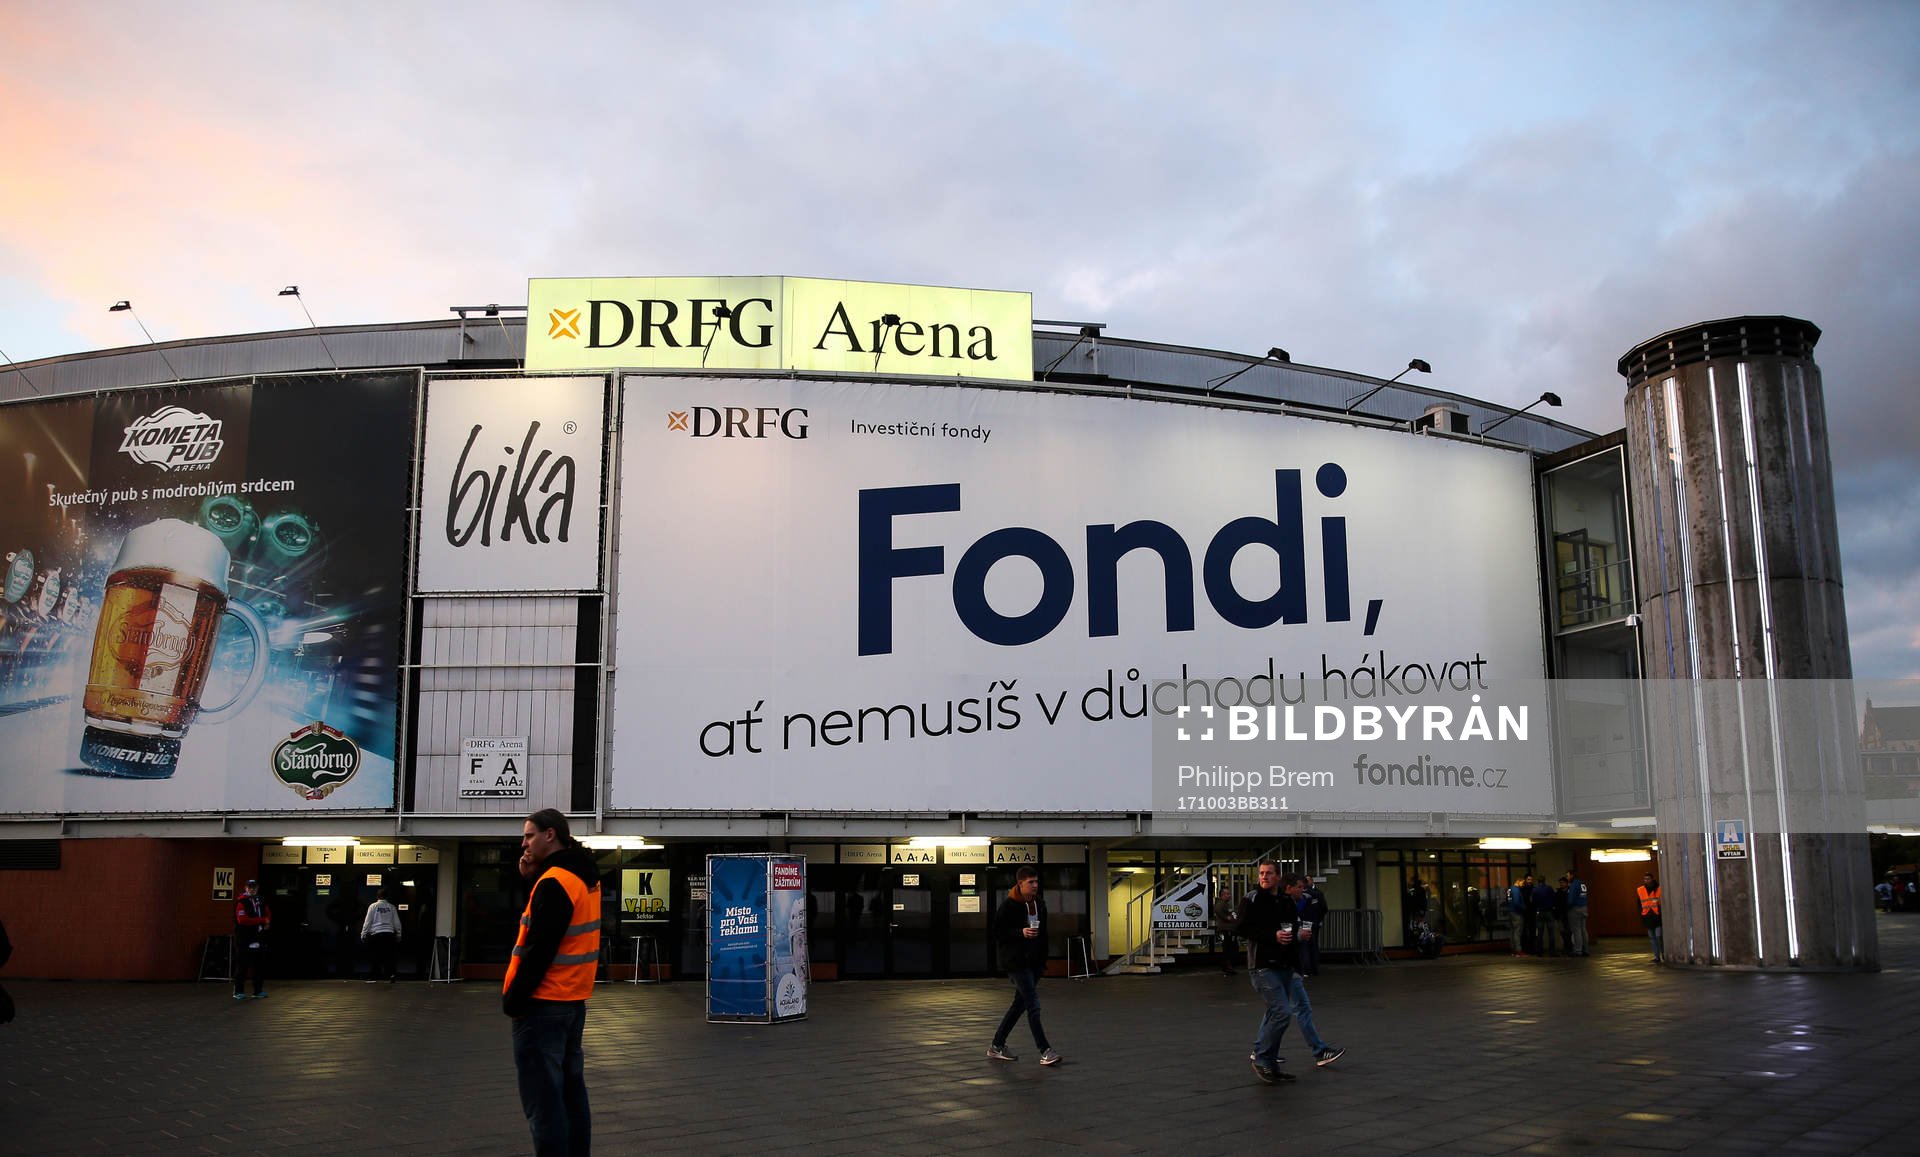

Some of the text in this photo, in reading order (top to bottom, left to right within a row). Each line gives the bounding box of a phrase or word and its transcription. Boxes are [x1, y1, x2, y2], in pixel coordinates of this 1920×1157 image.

[584, 298, 999, 361] DRFG Arena
[691, 406, 992, 440] DRFG Investiční fondy
[125, 423, 221, 447] KOMETA
[166, 441, 218, 463] PUB
[174, 463, 211, 472] ARENA
[49, 478, 295, 507] Skutečný pub s modrobílým srdcem
[446, 421, 576, 547] bika
[858, 462, 1384, 657] Fondi,
[783, 679, 1021, 750] nemusíš
[1035, 690, 1067, 726] v
[1081, 657, 1305, 722] důchodu
[1321, 650, 1489, 702] hákovat
[470, 740, 523, 748] DRFG Arena
[90, 744, 171, 765] KOMETA PUB
[280, 742, 353, 779] Starobrno
[471, 758, 483, 775] F
[501, 758, 518, 775] A
[1723, 822, 1739, 842] A
[323, 853, 329, 862] F
[416, 853, 422, 861] F
[894, 853, 902, 862] A
[997, 853, 1004, 862] A
[215, 871, 232, 886] WC
[775, 866, 798, 875] FANDÍME
[639, 872, 653, 896] K
[625, 898, 667, 912] V.I.P.
[726, 907, 752, 916] Místo
[720, 914, 758, 928] pro Vaší
[720, 925, 758, 936] reklamu
